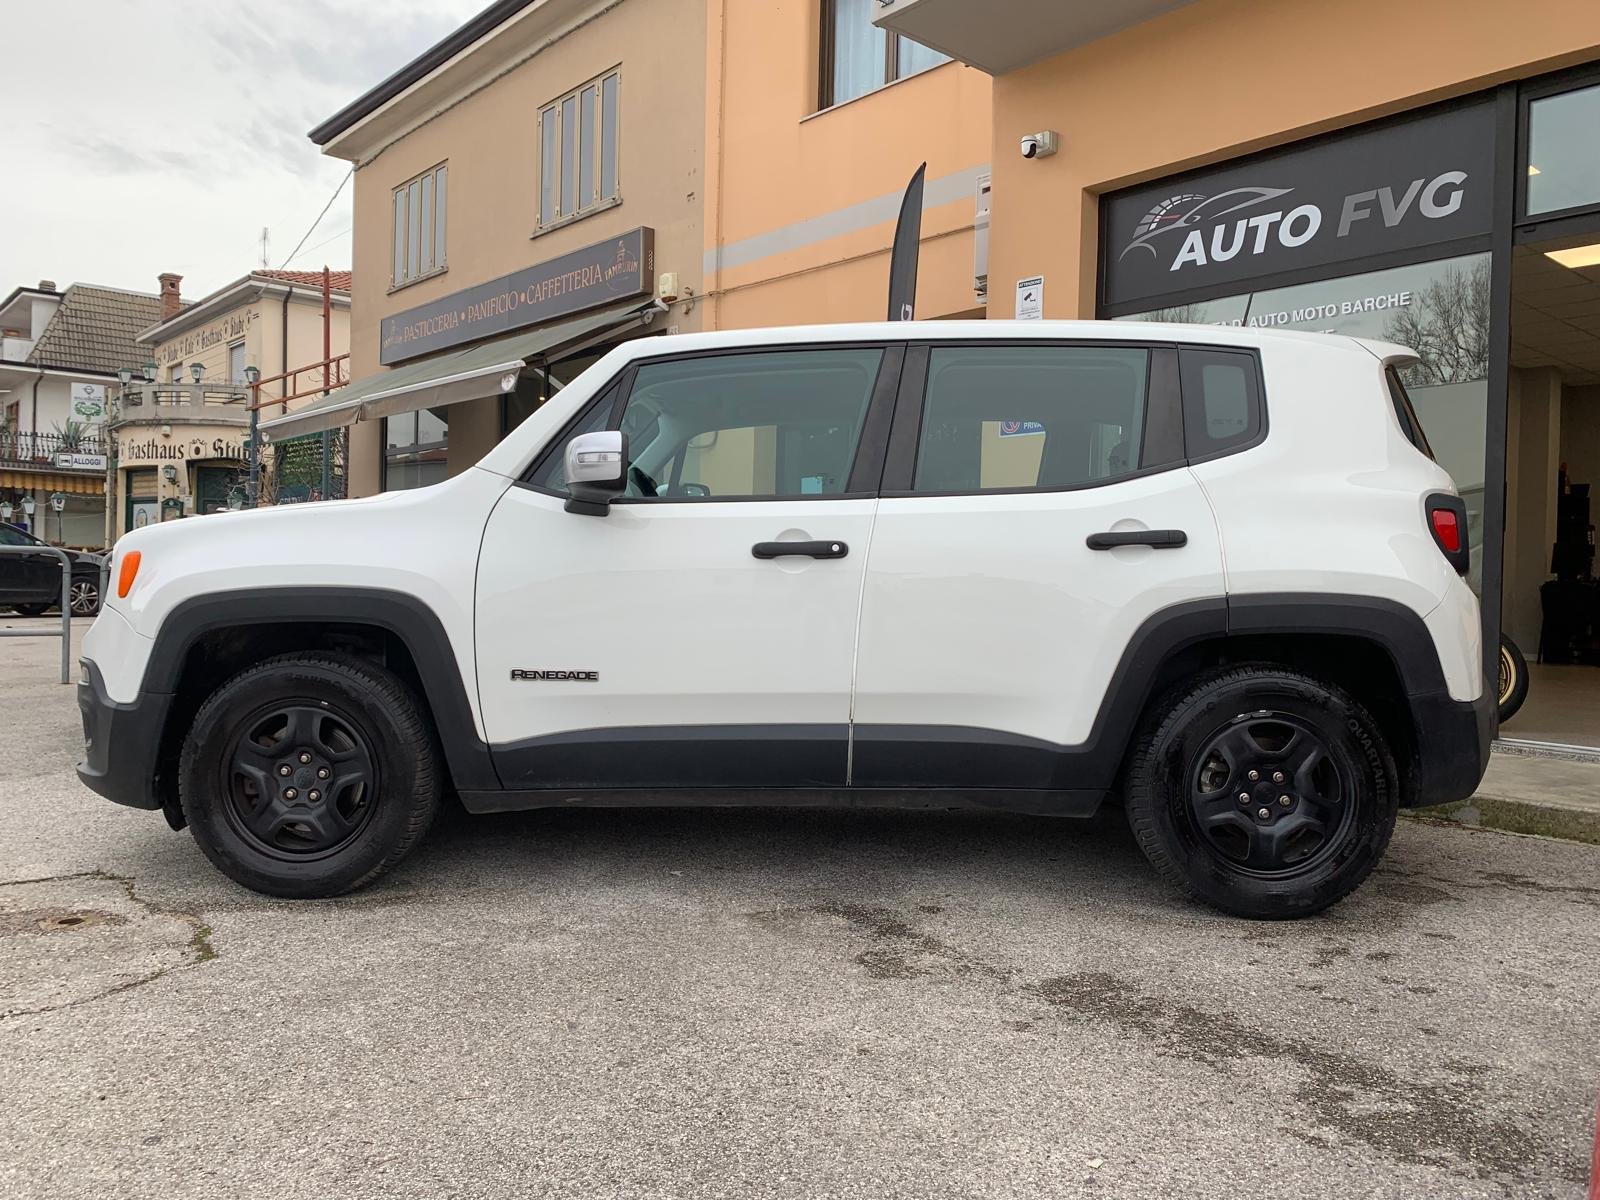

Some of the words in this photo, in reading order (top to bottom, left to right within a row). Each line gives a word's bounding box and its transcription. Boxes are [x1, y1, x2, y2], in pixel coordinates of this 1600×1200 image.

[1169, 204, 1322, 272] AUTO
[1336, 170, 1469, 239] FVG
[403, 311, 459, 342] PASTICCERIA
[467, 291, 519, 323] PANIFICIO
[526, 263, 603, 306] CAFFETTERIA
[1249, 311, 1289, 328] AUTO
[1292, 305, 1337, 322] MOTO
[1341, 291, 1410, 315] BARCHE
[73, 457, 101, 466] ALLOGGI
[128, 438, 184, 460] Gasthaus
[511, 669, 599, 681] RENEGADE
